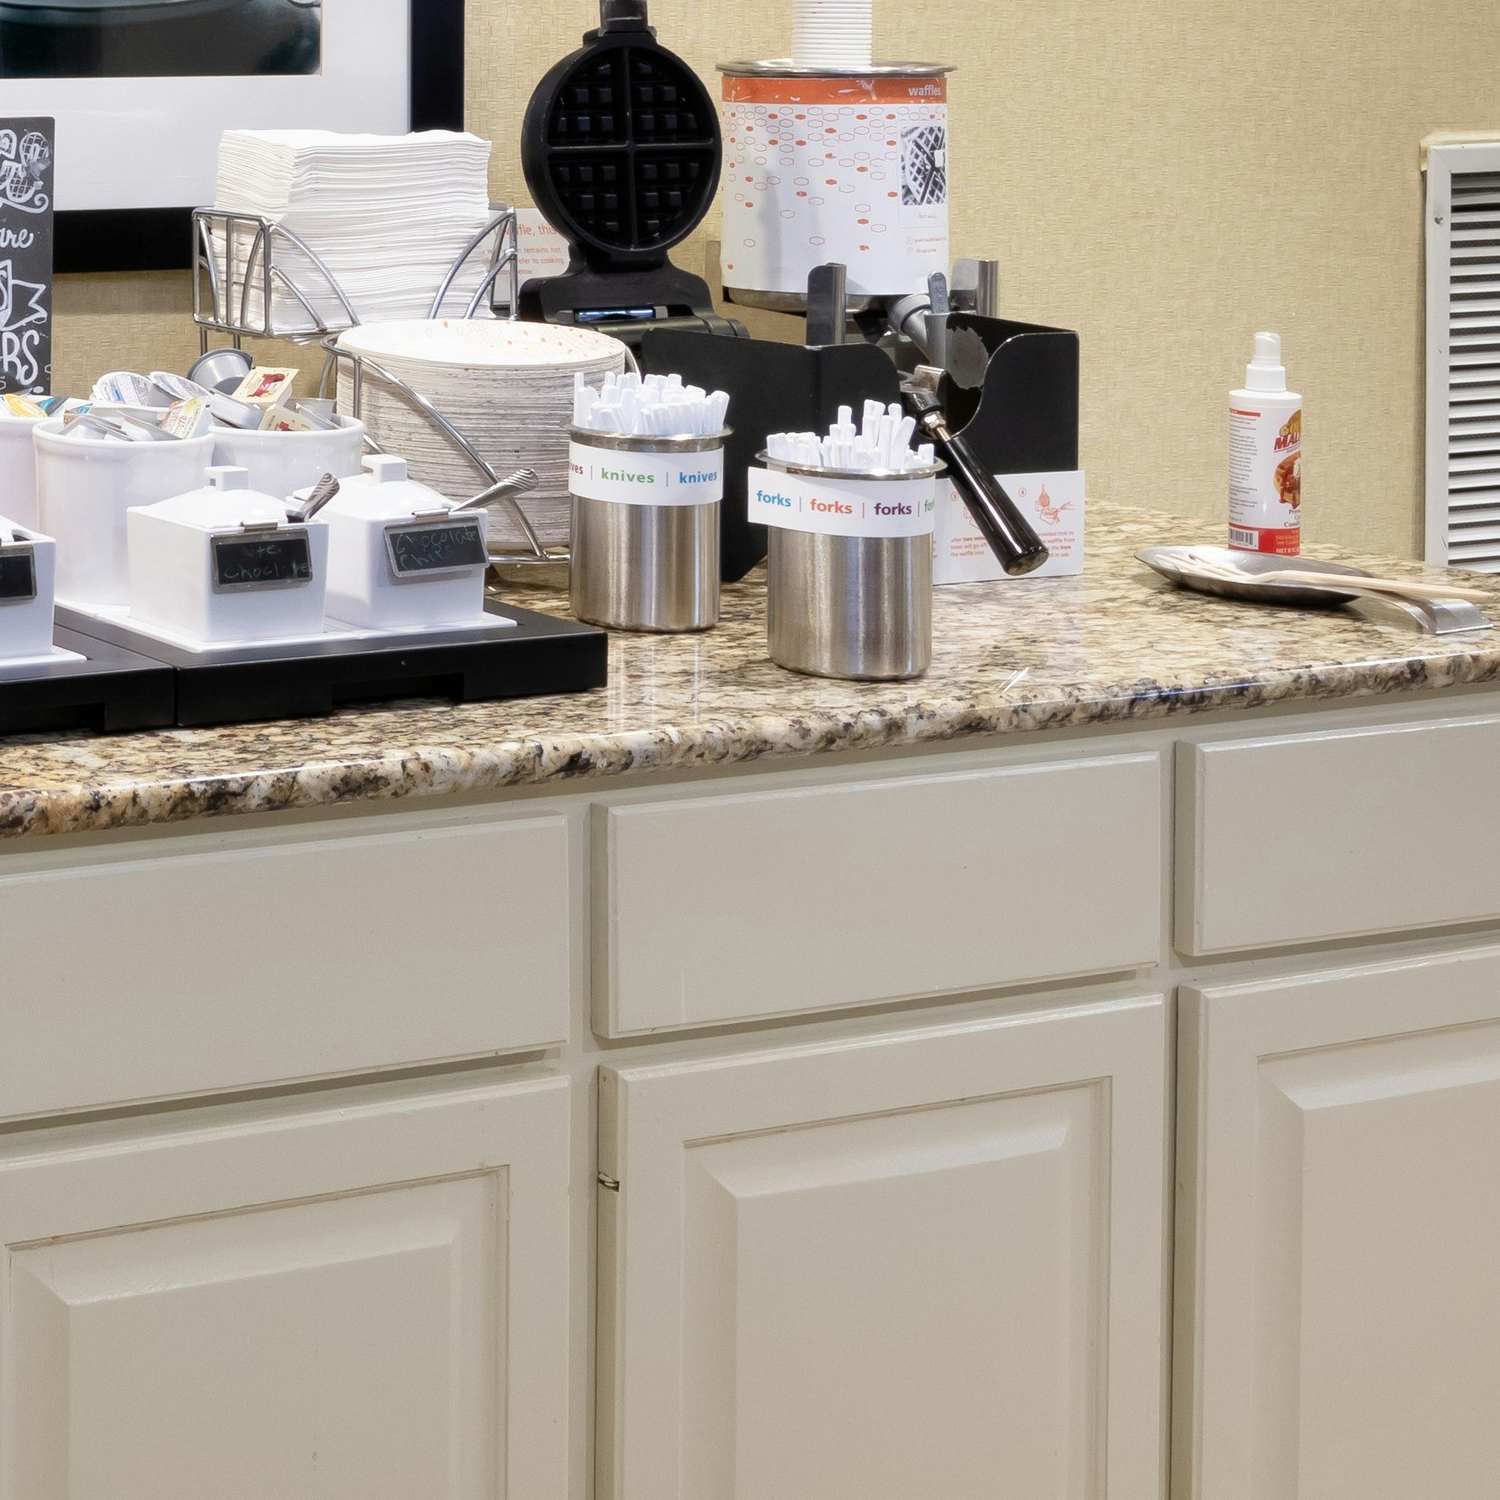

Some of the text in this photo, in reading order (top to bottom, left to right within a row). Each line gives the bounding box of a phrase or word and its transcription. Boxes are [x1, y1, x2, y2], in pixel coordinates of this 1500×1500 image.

[601, 467, 655, 484] knives
[679, 471, 718, 484] knives
[756, 489, 791, 508] forks
[809, 498, 853, 515] forks
[873, 502, 912, 516] forks
